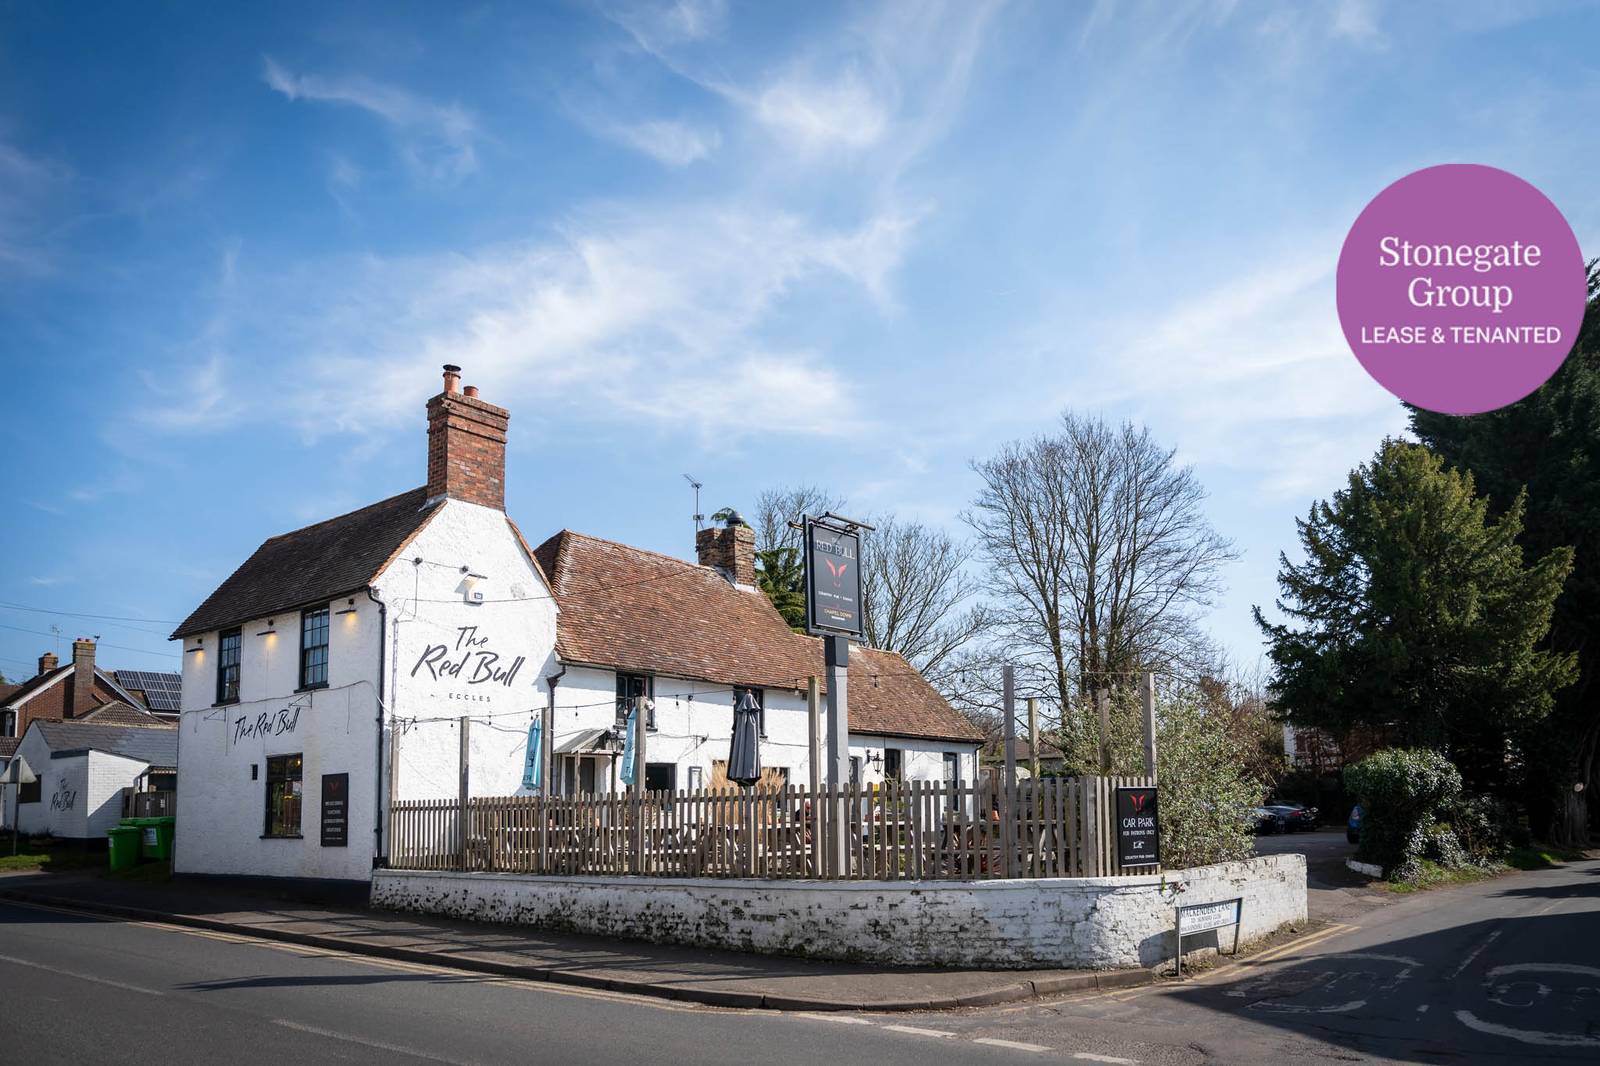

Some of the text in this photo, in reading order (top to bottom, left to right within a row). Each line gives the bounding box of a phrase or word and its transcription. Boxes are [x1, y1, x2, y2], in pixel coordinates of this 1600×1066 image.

[816, 539, 832, 553] RED
[835, 543, 855, 560] BULL
[456, 625, 489, 651] The
[411, 644, 526, 687] Red Bull
[448, 692, 491, 703] ECCLES
[233, 706, 301, 745] The Red Bull
[1123, 817, 1154, 828] CAR PARK
